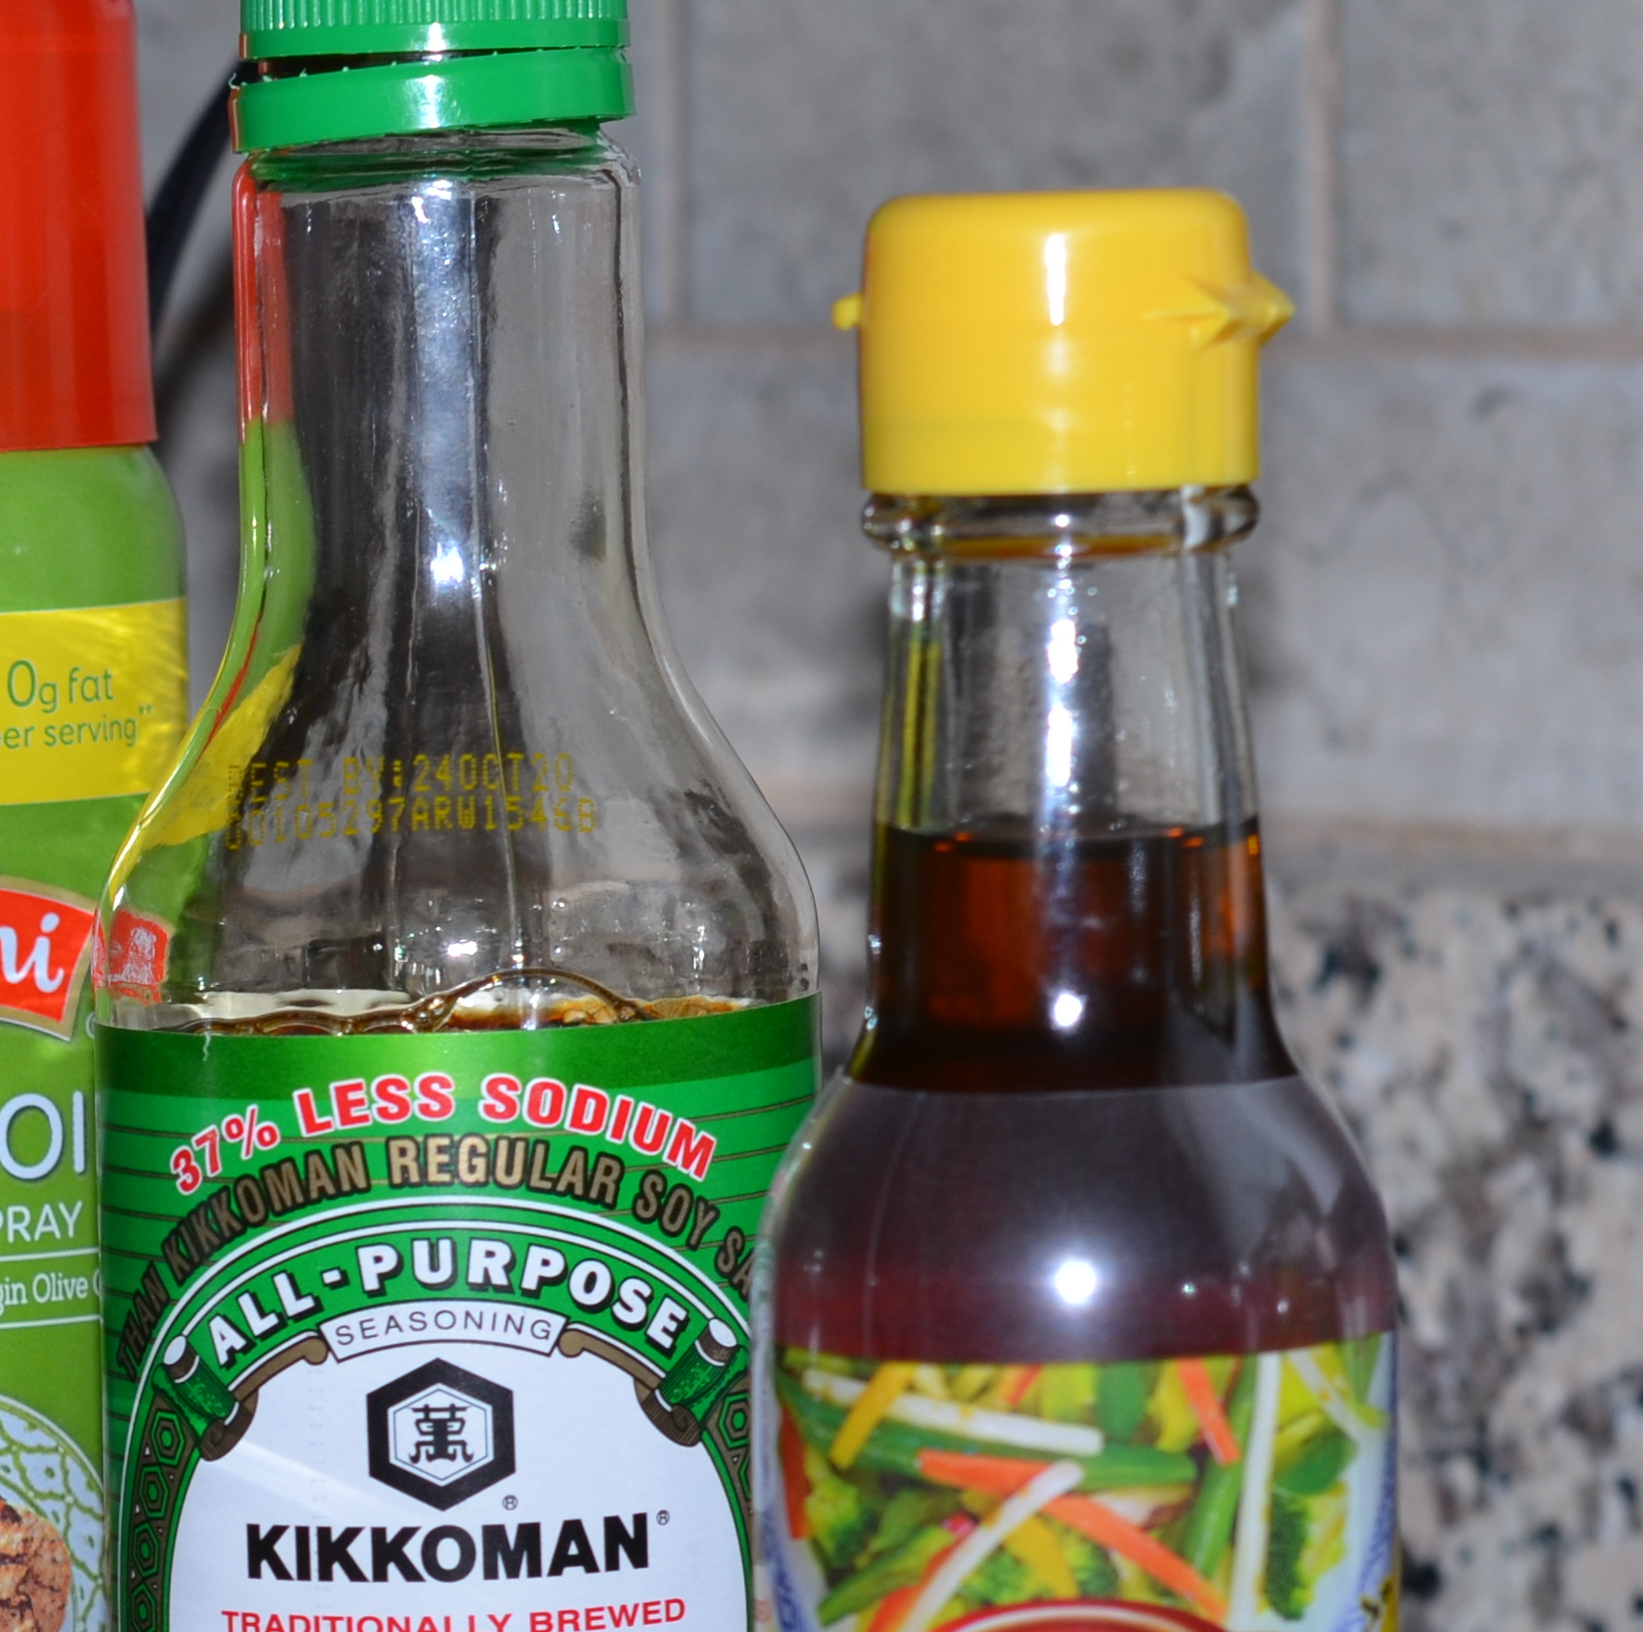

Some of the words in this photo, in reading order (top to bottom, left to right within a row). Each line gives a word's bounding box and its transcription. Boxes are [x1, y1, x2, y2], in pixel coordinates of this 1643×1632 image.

[5, 658, 59, 714] 0g
[68, 666, 115, 705] fat
[226, 758, 314, 807] BEST
[169, 1105, 280, 1194] 37%
[292, 1072, 455, 1138] LESS
[479, 1073, 719, 1181] SODIUM
[32, 1270, 89, 1304] Olive
[116, 1260, 171, 1384] THAN
[161, 1141, 372, 1288] KIKKOMAN
[386, 1133, 625, 1211] REGULAR
[635, 1170, 722, 1252] SOY
[207, 1237, 691, 1377] ALL-PURPOSE
[333, 1308, 556, 1346] SEASONING
[244, 1511, 650, 1584] KIKKOMAN
